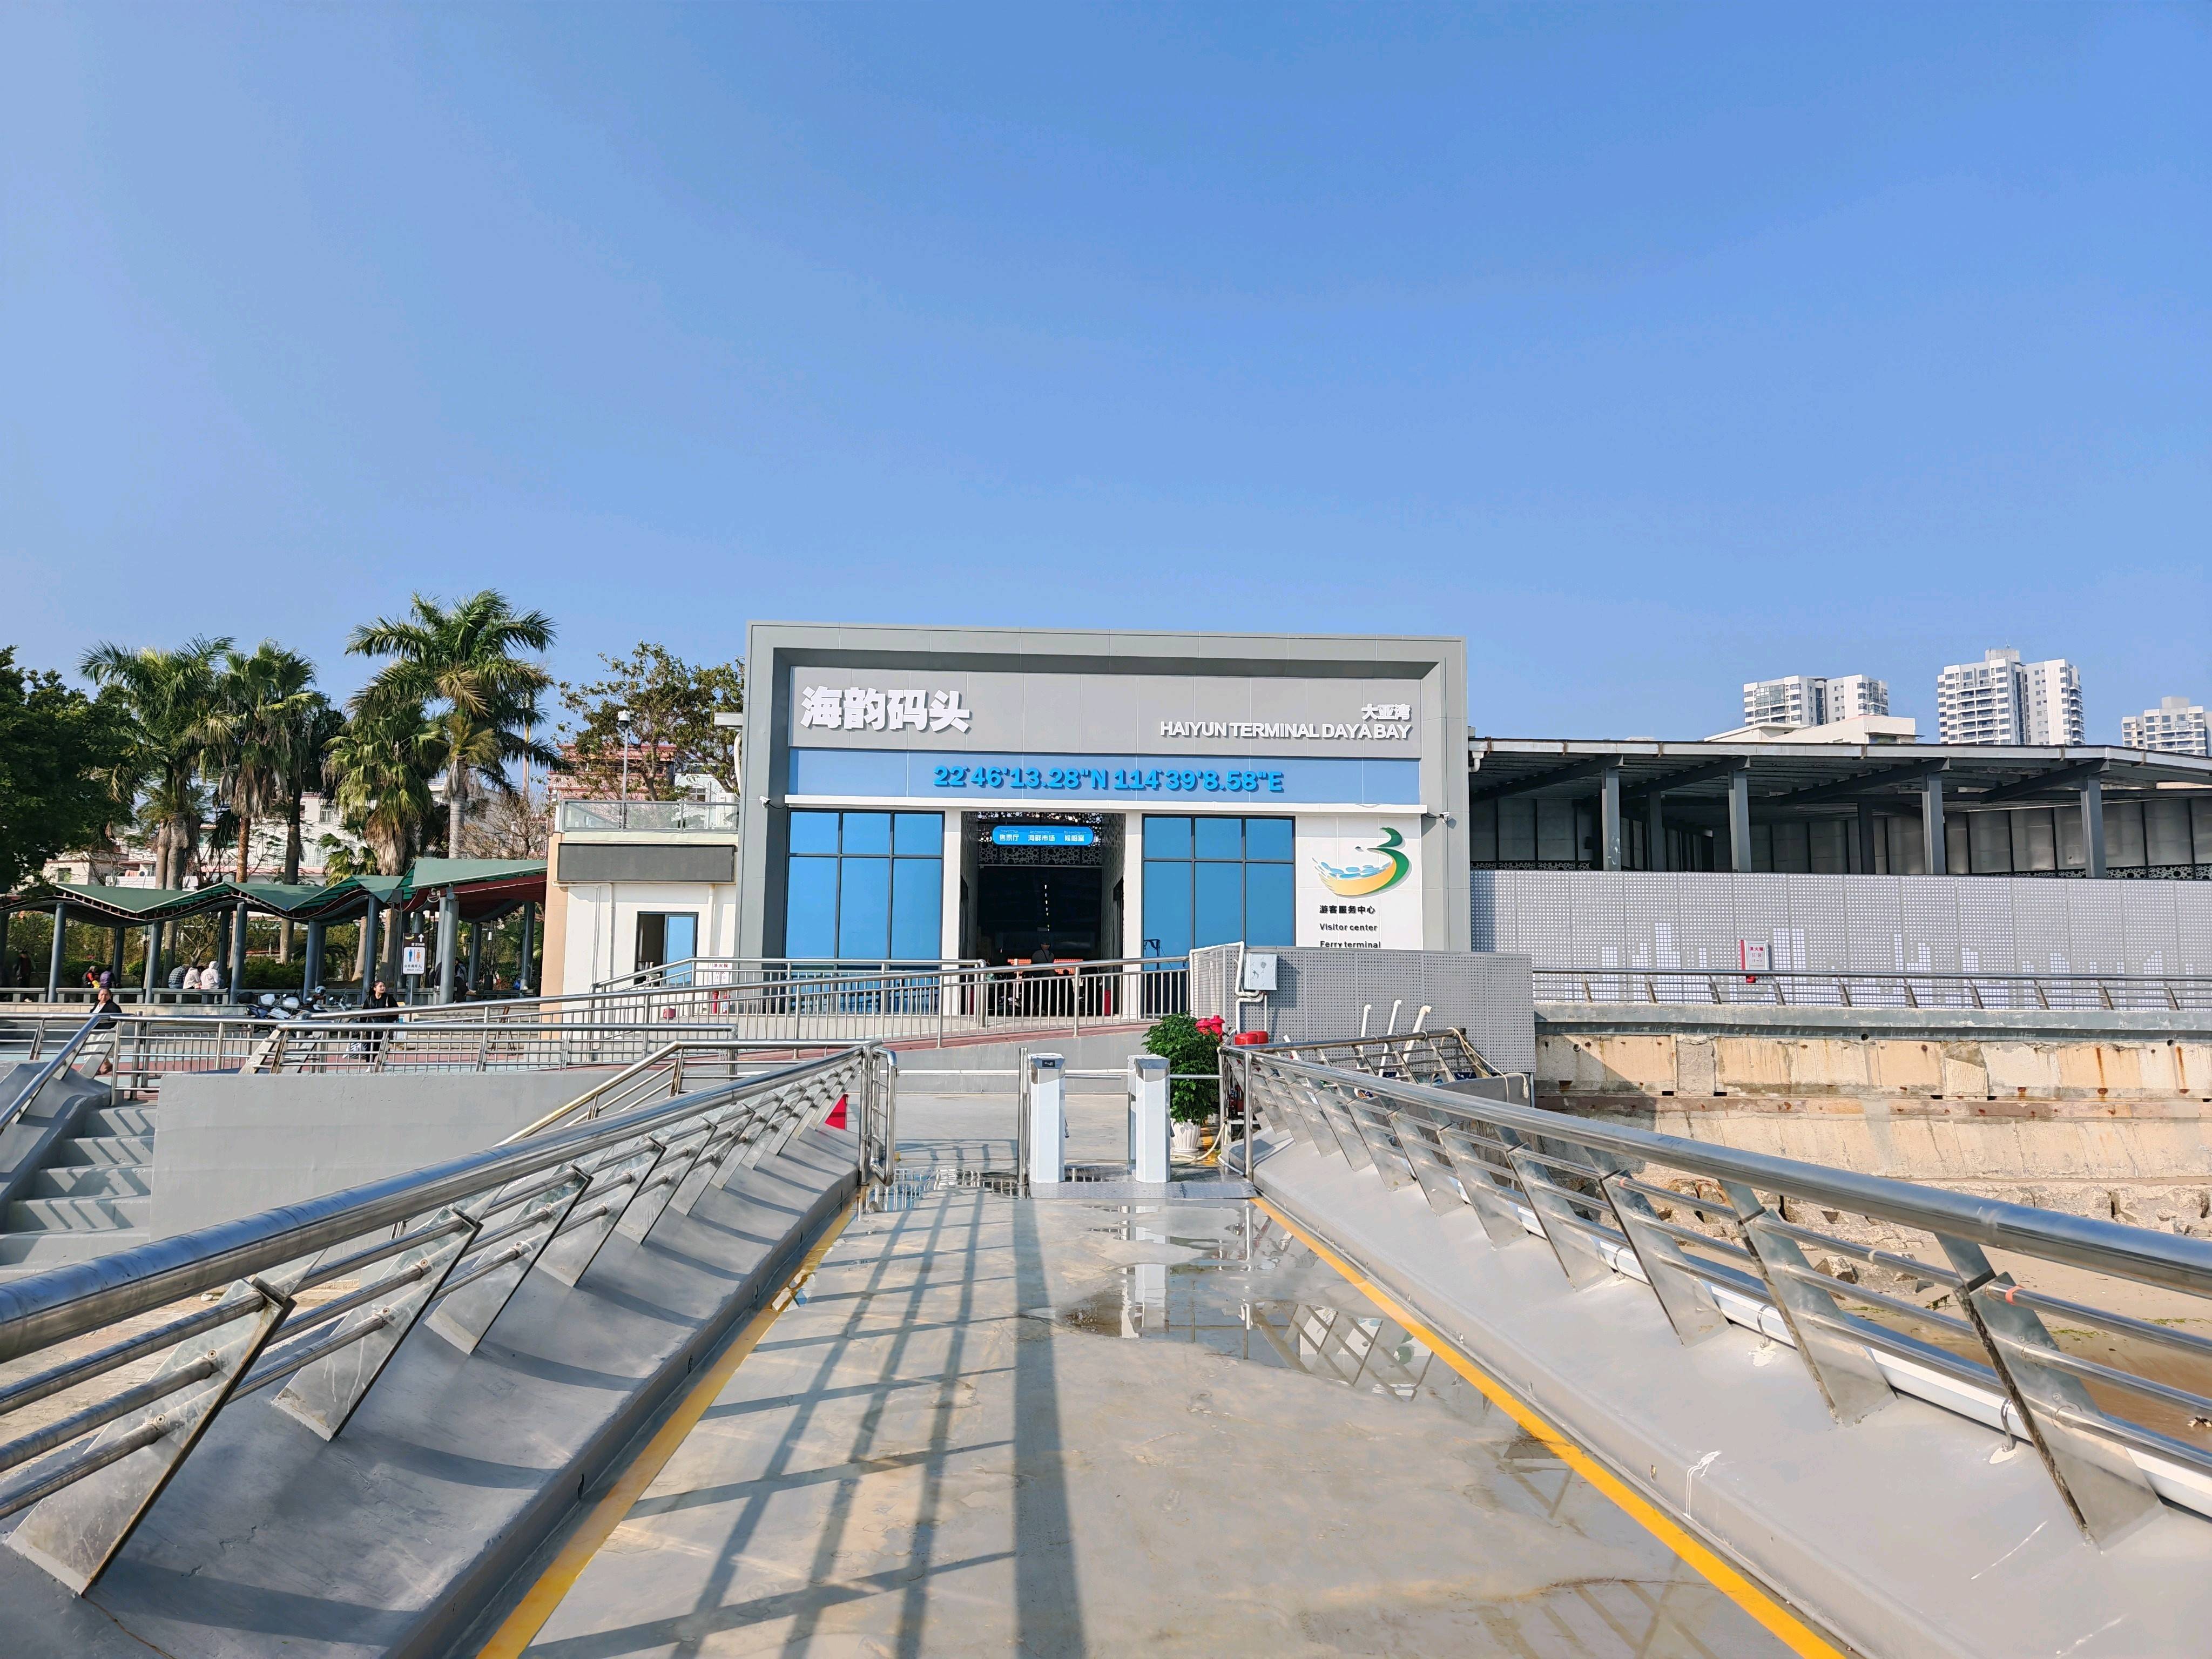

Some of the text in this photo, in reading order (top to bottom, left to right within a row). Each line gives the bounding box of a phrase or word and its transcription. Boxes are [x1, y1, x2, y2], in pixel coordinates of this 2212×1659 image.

[800, 685, 970, 732] 海韵码头
[1361, 704, 1410, 720] 大亚湾
[1161, 721, 1411, 739] HAIYUN TERMINAL DAYA BAY
[1319, 905, 1375, 915] 游客服务中心
